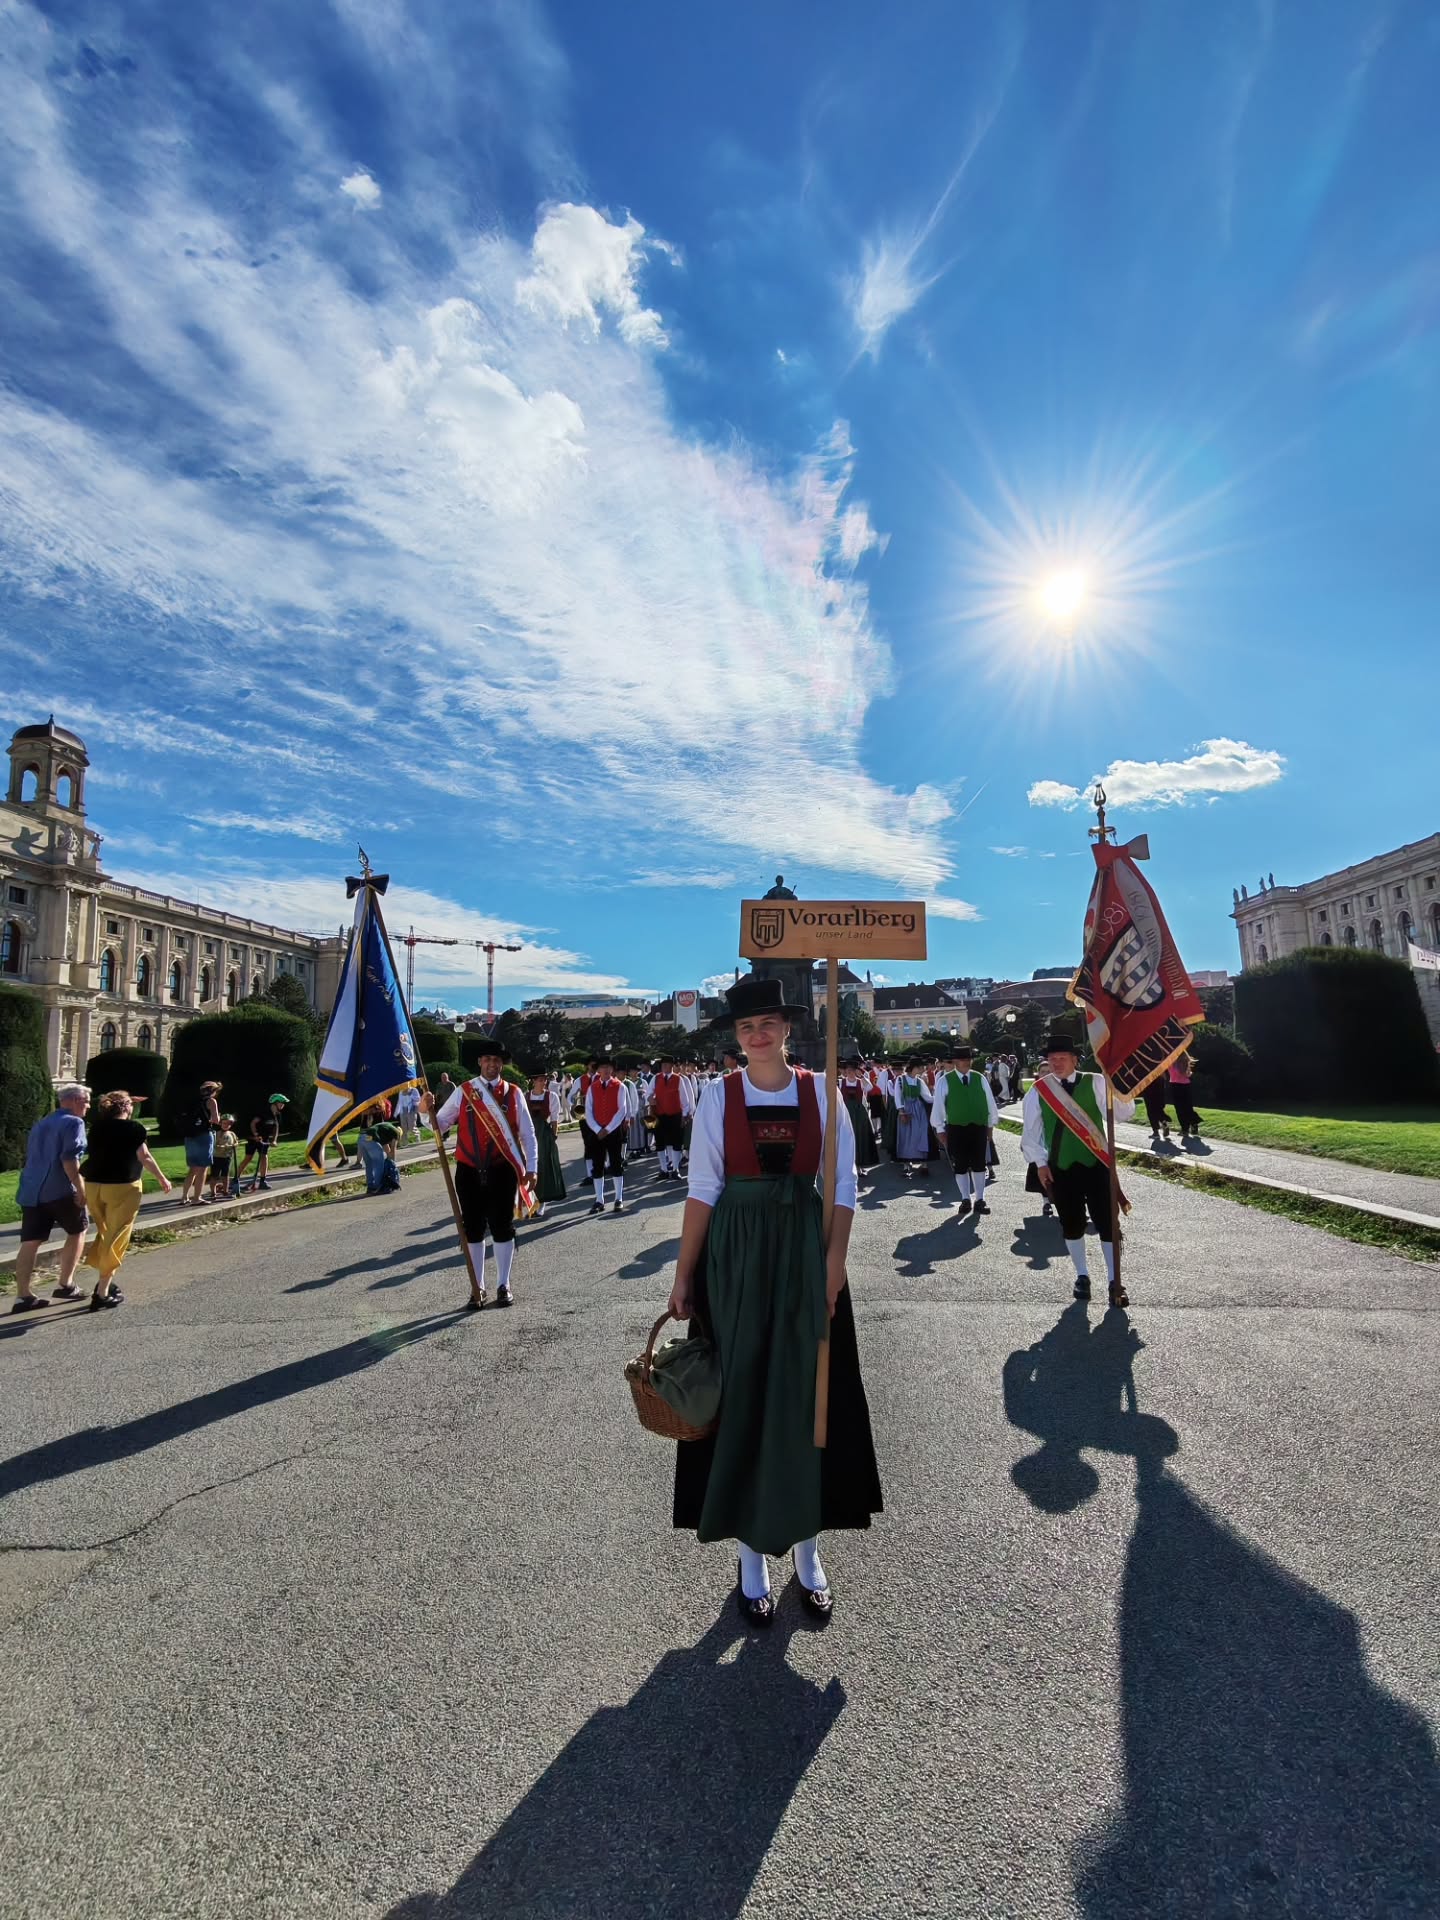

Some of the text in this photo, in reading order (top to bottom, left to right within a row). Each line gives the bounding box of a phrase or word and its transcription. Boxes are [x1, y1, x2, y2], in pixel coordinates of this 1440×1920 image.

[788, 907, 916, 932] Vorarlberg
[815, 930, 873, 939] unser Land
